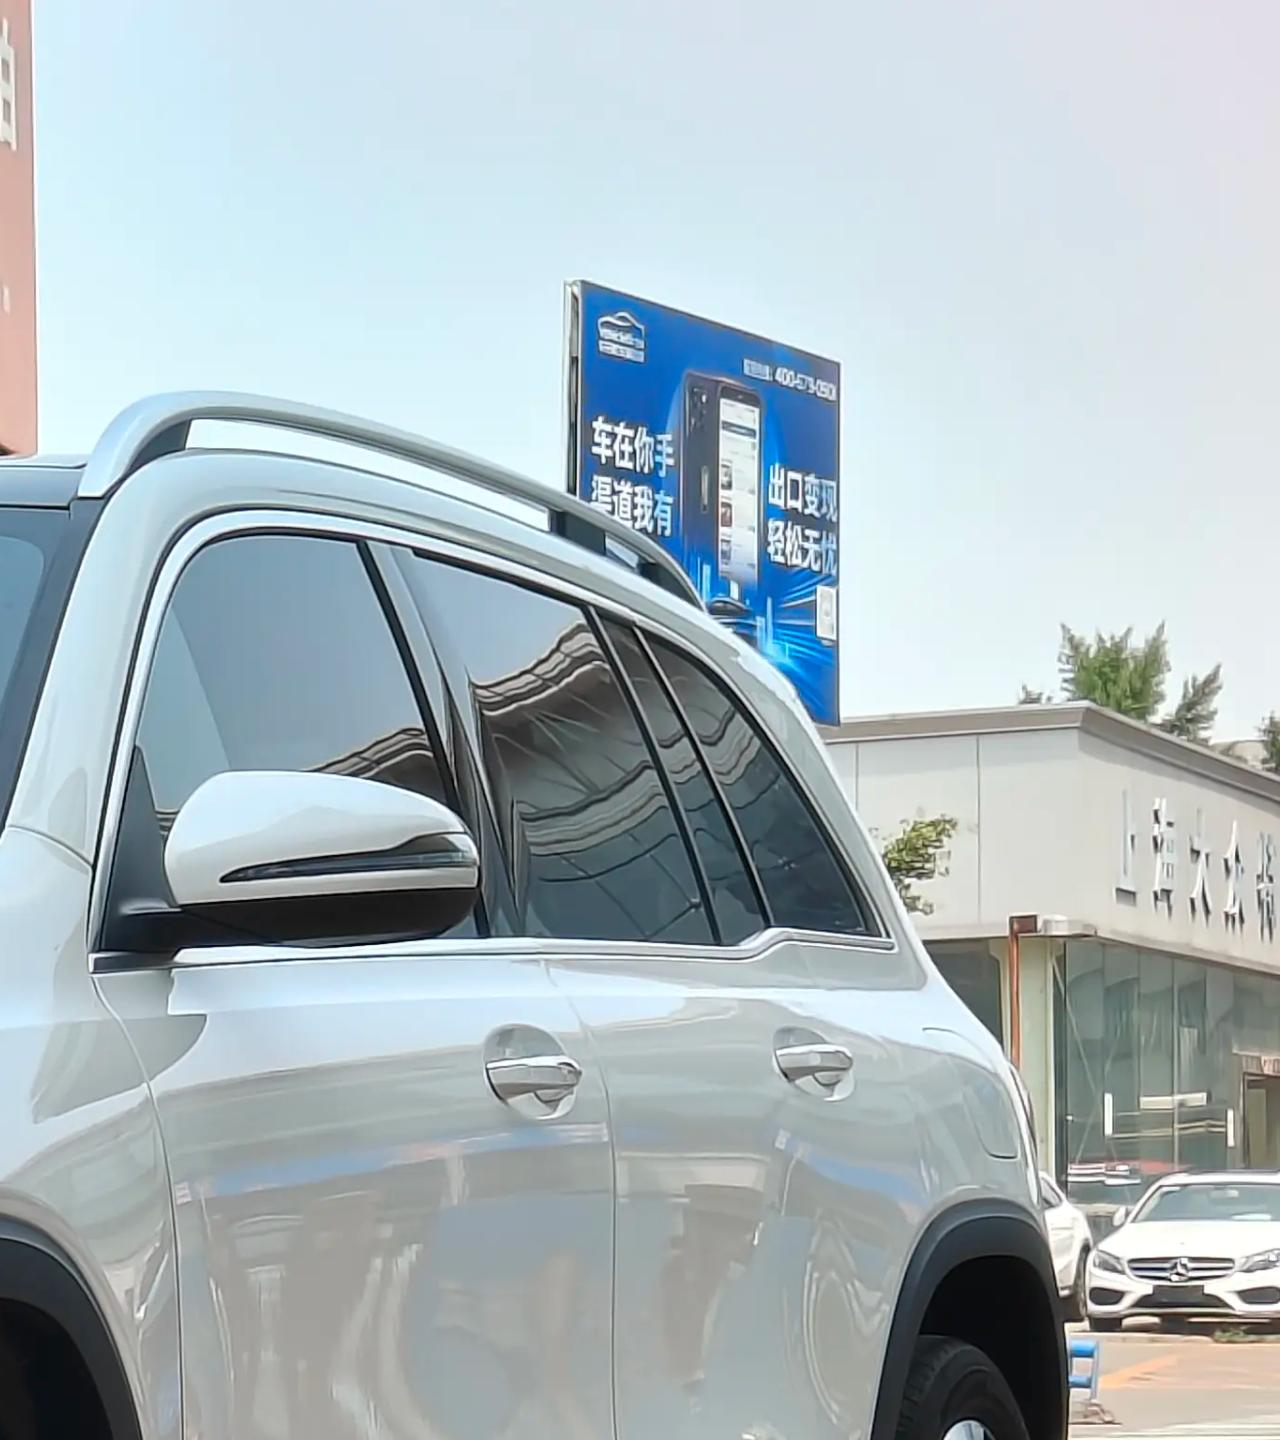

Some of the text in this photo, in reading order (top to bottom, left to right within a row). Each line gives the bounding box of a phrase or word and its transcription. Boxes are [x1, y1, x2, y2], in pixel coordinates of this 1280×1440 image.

[591, 416, 674, 477] 车在你手
[769, 464, 837, 523] 出口变现
[767, 521, 838, 576] 轻松无忧
